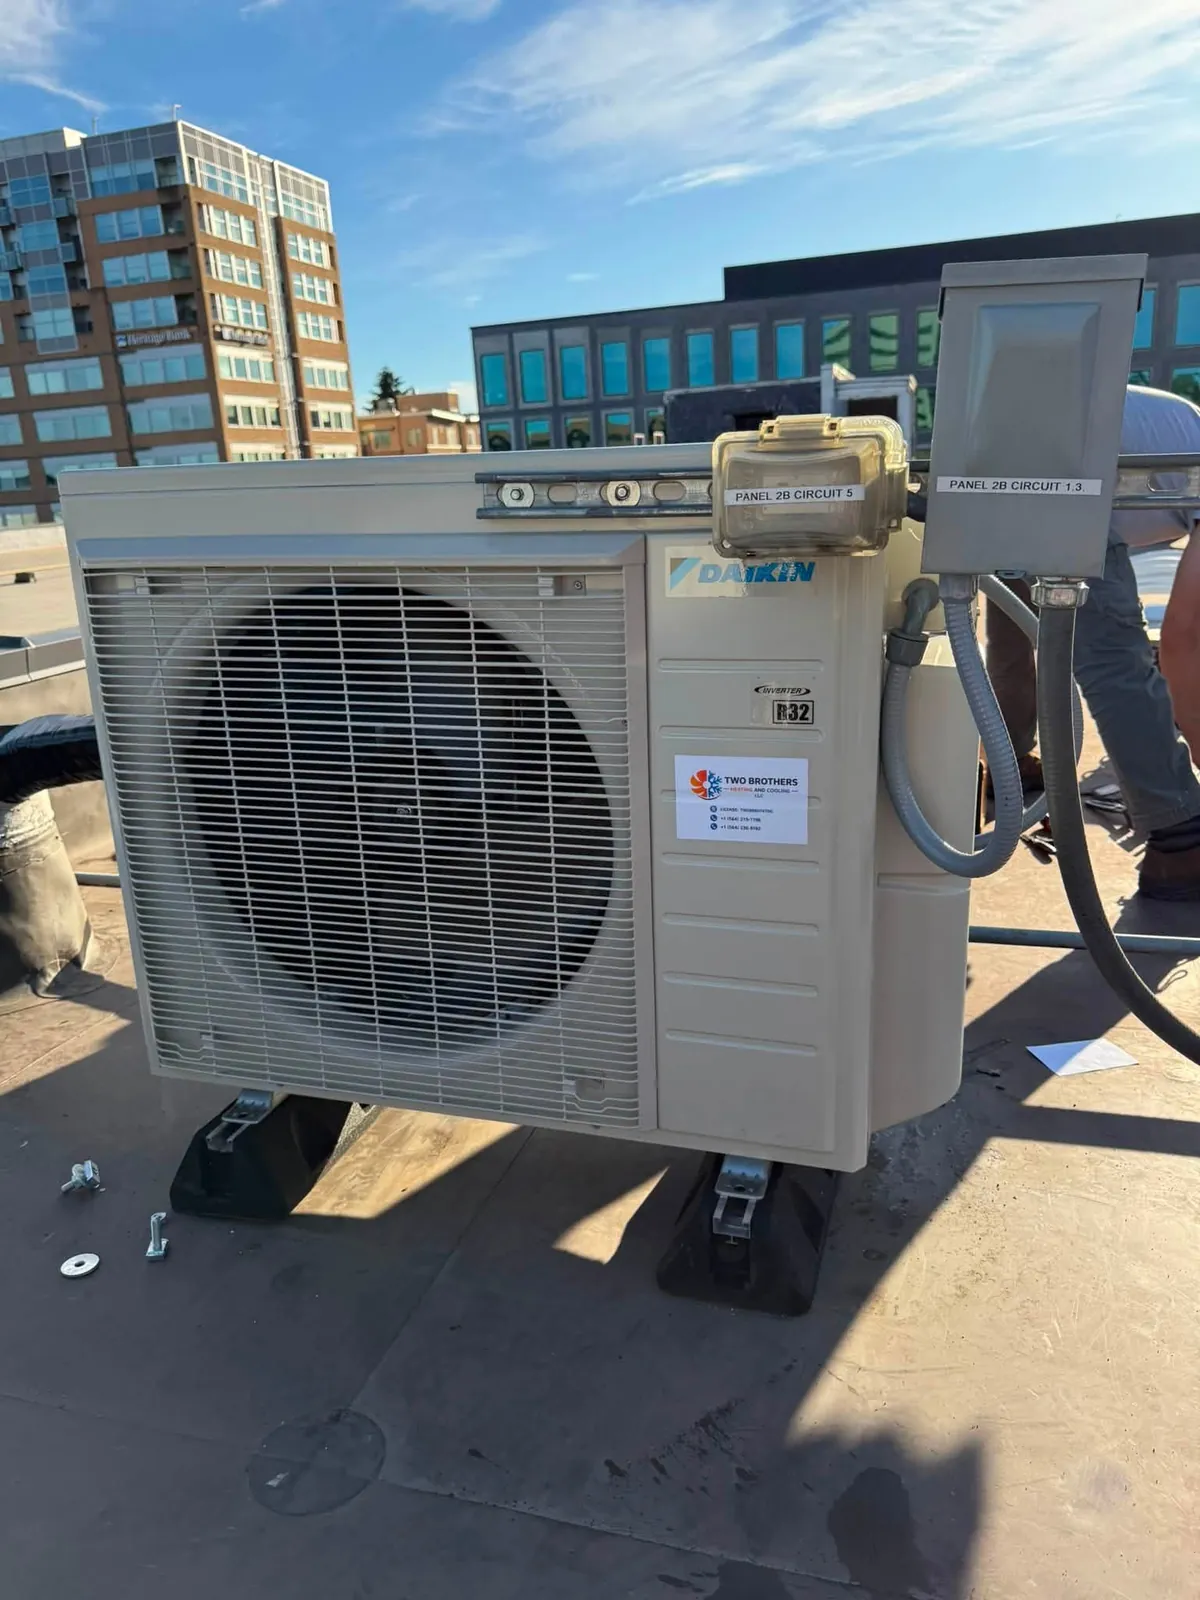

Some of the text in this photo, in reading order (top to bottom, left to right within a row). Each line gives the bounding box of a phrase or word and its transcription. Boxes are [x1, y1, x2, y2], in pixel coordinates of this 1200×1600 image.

[950, 479, 988, 490] PANEL
[992, 480, 1007, 490] 2B
[1010, 481, 1062, 492] CIRCUIT
[735, 488, 853, 501] PANEL 2B CIRCUIT 5
[698, 561, 816, 584] DAIKIN
[777, 703, 810, 721] R32
[724, 776, 799, 787] TWO BROTHERS
